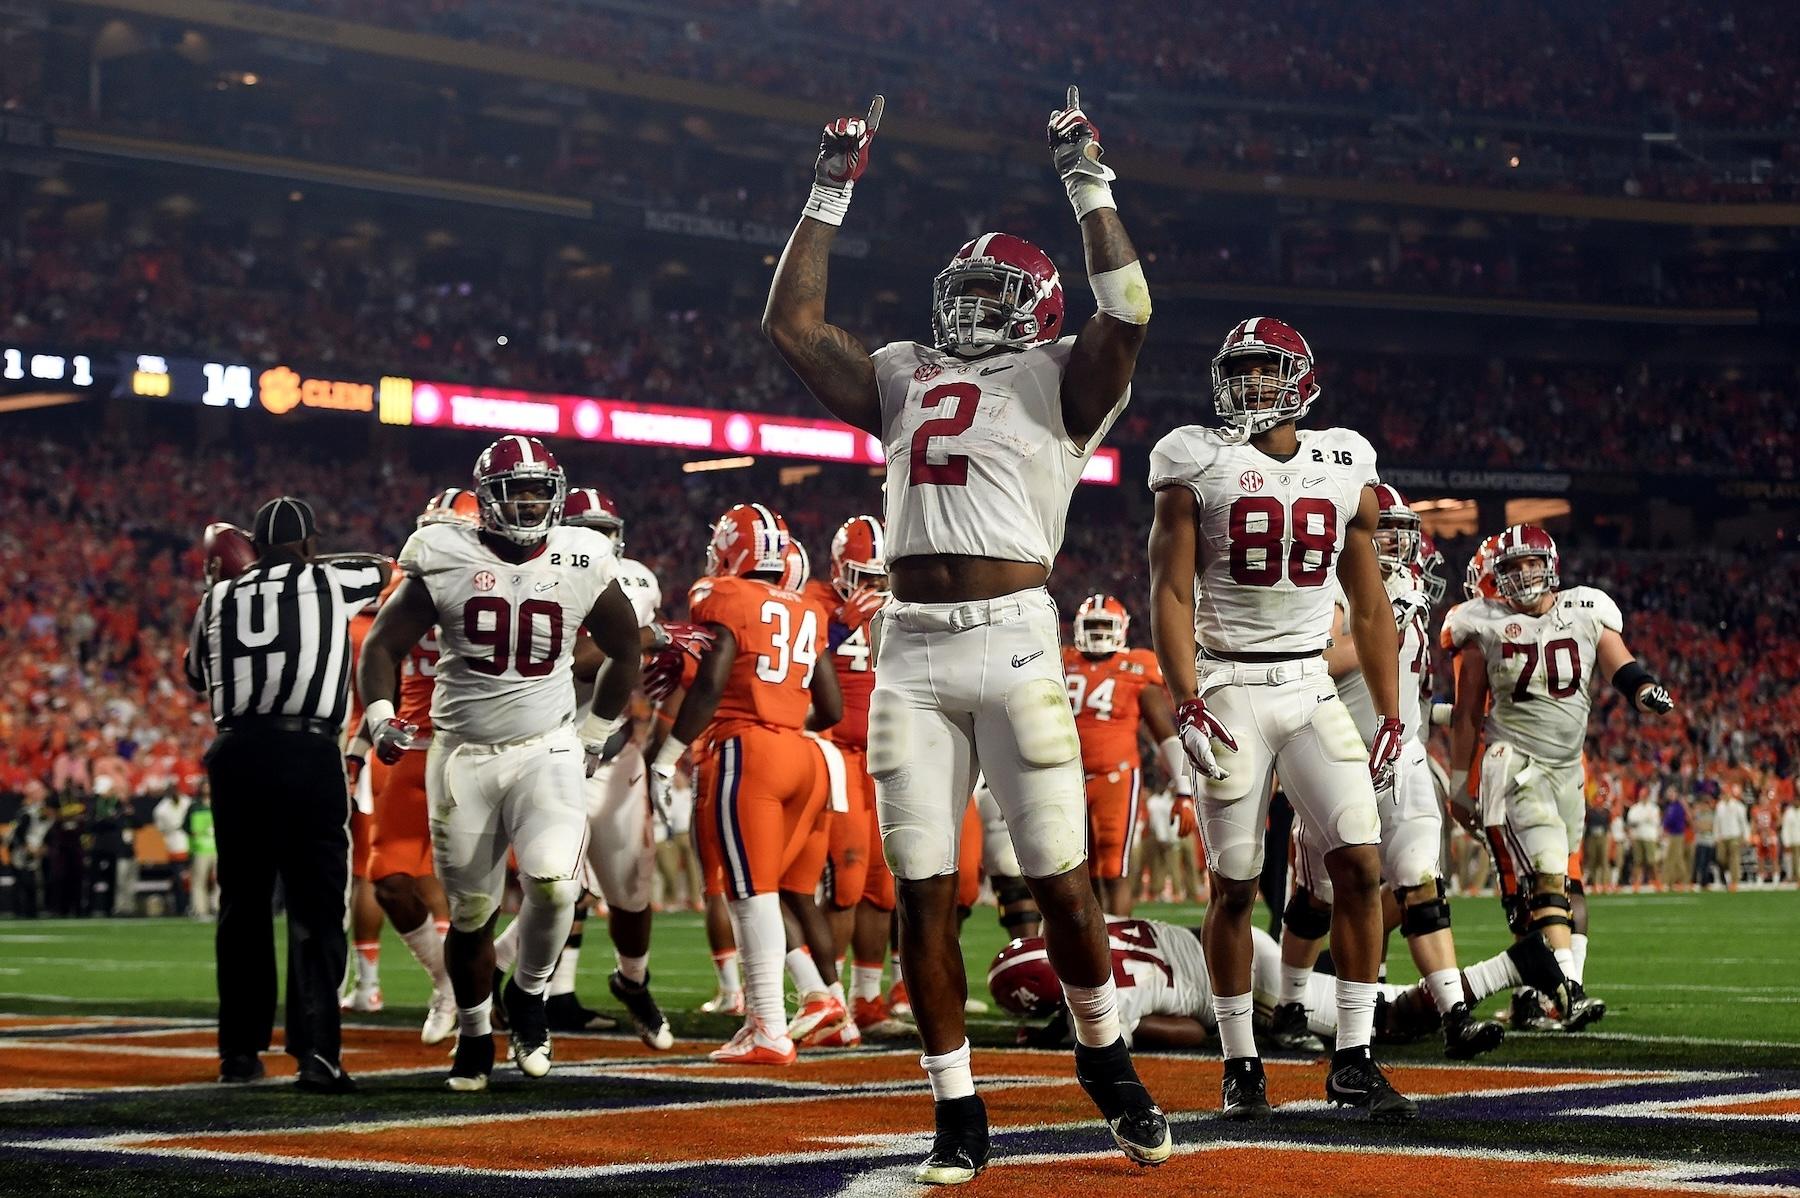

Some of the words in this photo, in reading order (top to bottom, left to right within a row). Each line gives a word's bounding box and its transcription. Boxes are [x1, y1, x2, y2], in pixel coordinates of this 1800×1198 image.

[202, 362, 252, 408] 14
[910, 382, 982, 486] 2
[1240, 471, 1264, 492] SEC
[1381, 469, 1447, 489] TIONAL
[1229, 496, 1337, 587] 88
[234, 581, 285, 648] U
[464, 596, 563, 677] 90
[756, 600, 817, 689] 34
[1066, 674, 1116, 721] 94
[1502, 638, 1582, 702] 70
[1106, 919, 1175, 989] 74
[1011, 987, 1040, 1010] 74
